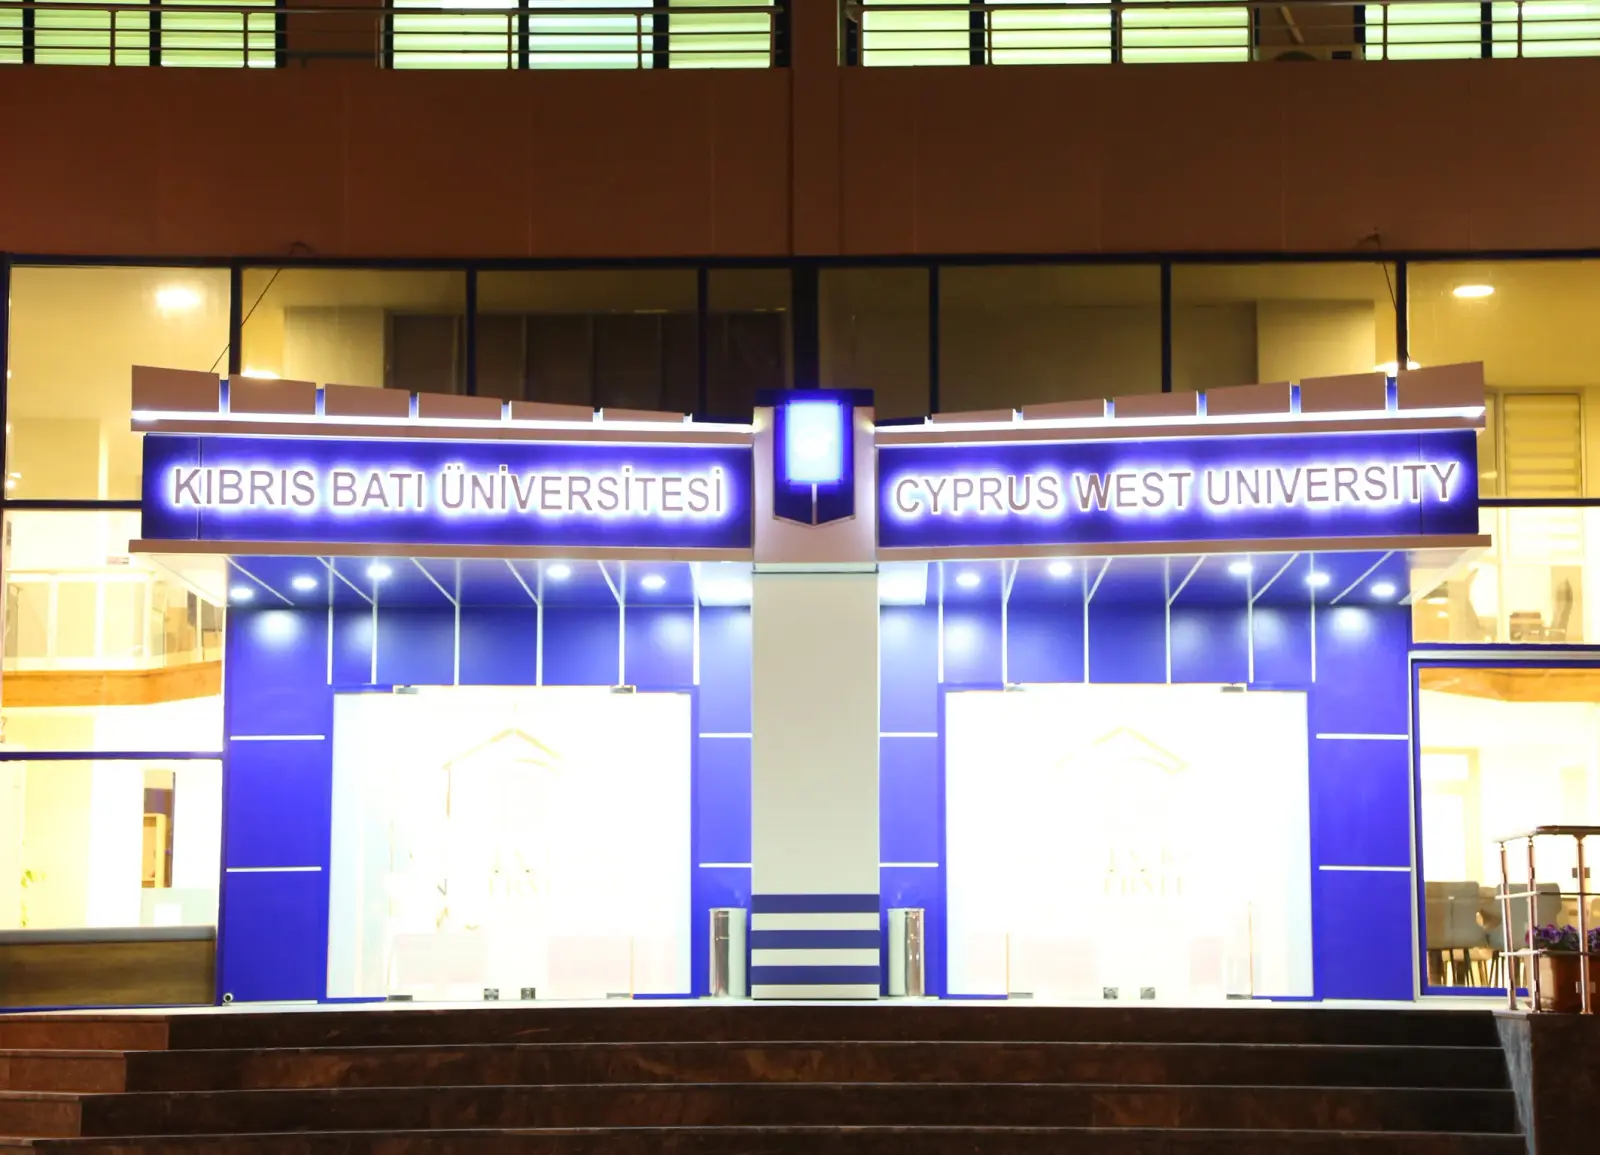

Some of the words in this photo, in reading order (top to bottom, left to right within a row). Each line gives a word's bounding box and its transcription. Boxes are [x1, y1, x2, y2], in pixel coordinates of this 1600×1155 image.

[174, 468, 316, 507] KIBRIS
[332, 471, 423, 508] BATI
[441, 464, 721, 512] ÜNİVERSİTESİ
[895, 474, 1059, 513] CYPRUS
[1074, 471, 1192, 510] WEST
[1206, 462, 1457, 506] UNIVERSITY
